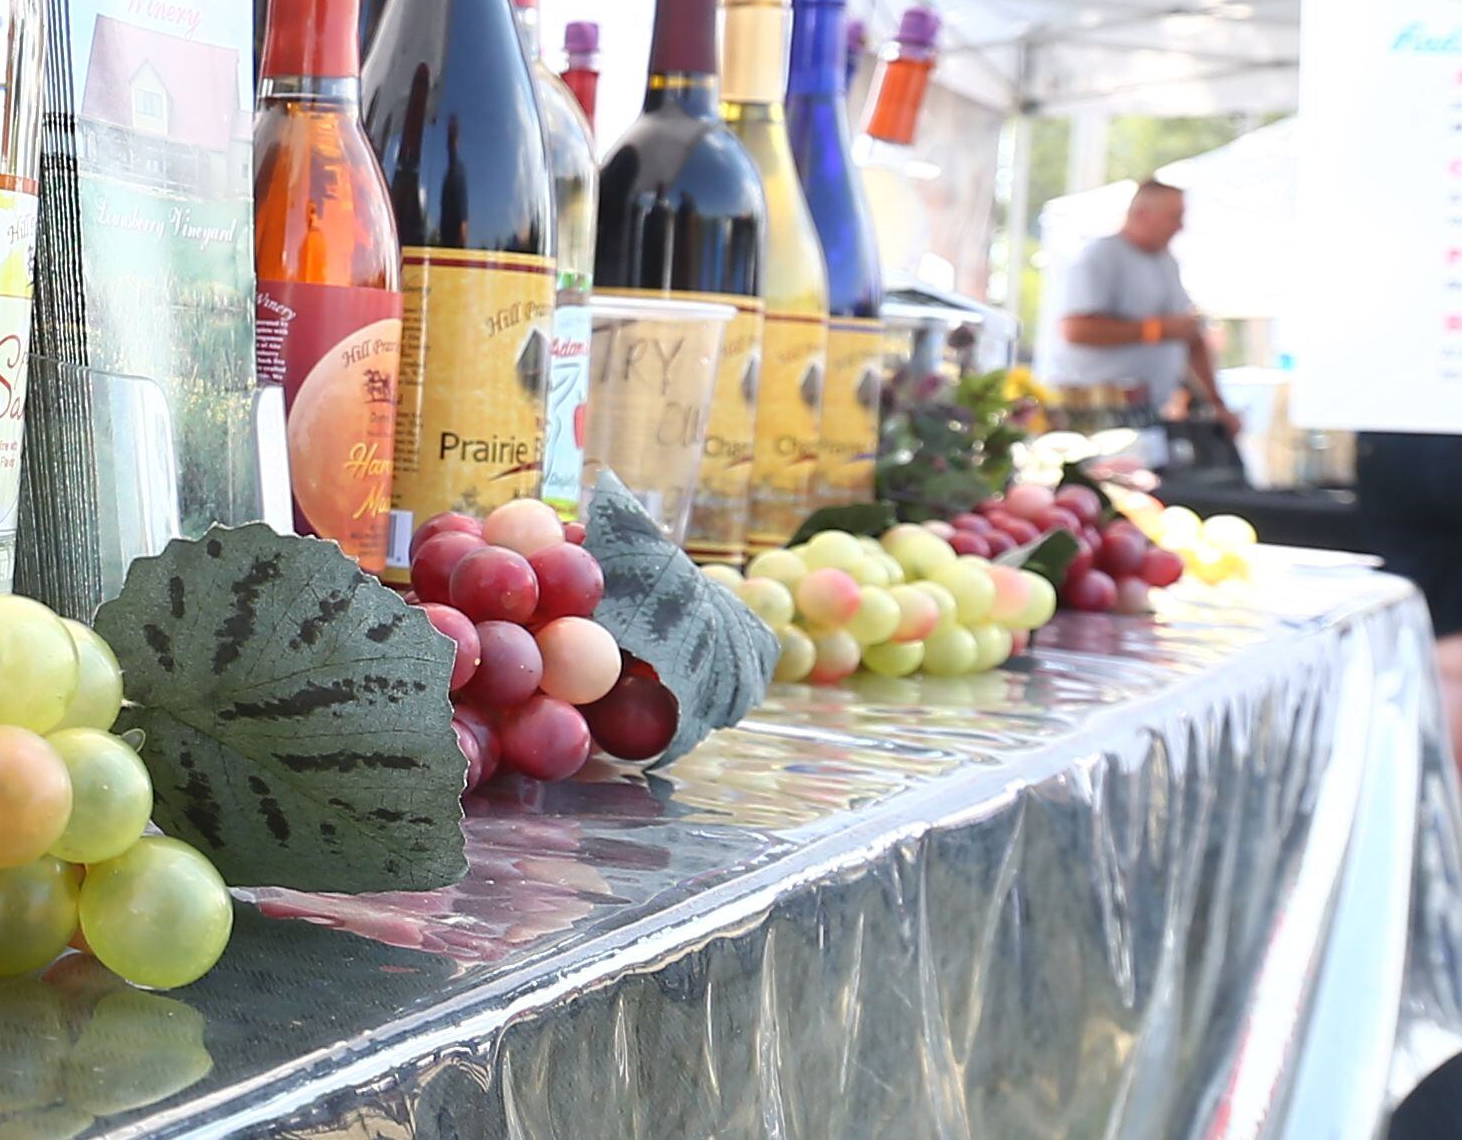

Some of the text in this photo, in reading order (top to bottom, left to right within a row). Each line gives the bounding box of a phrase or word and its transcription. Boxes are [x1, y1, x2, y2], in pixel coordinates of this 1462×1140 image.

[169, 207, 237, 250] Vineyard
[485, 301, 522, 337] Hill
[342, 340, 370, 368] Hill
[592, 318, 684, 397] TRY
[439, 431, 529, 464] Prairie
